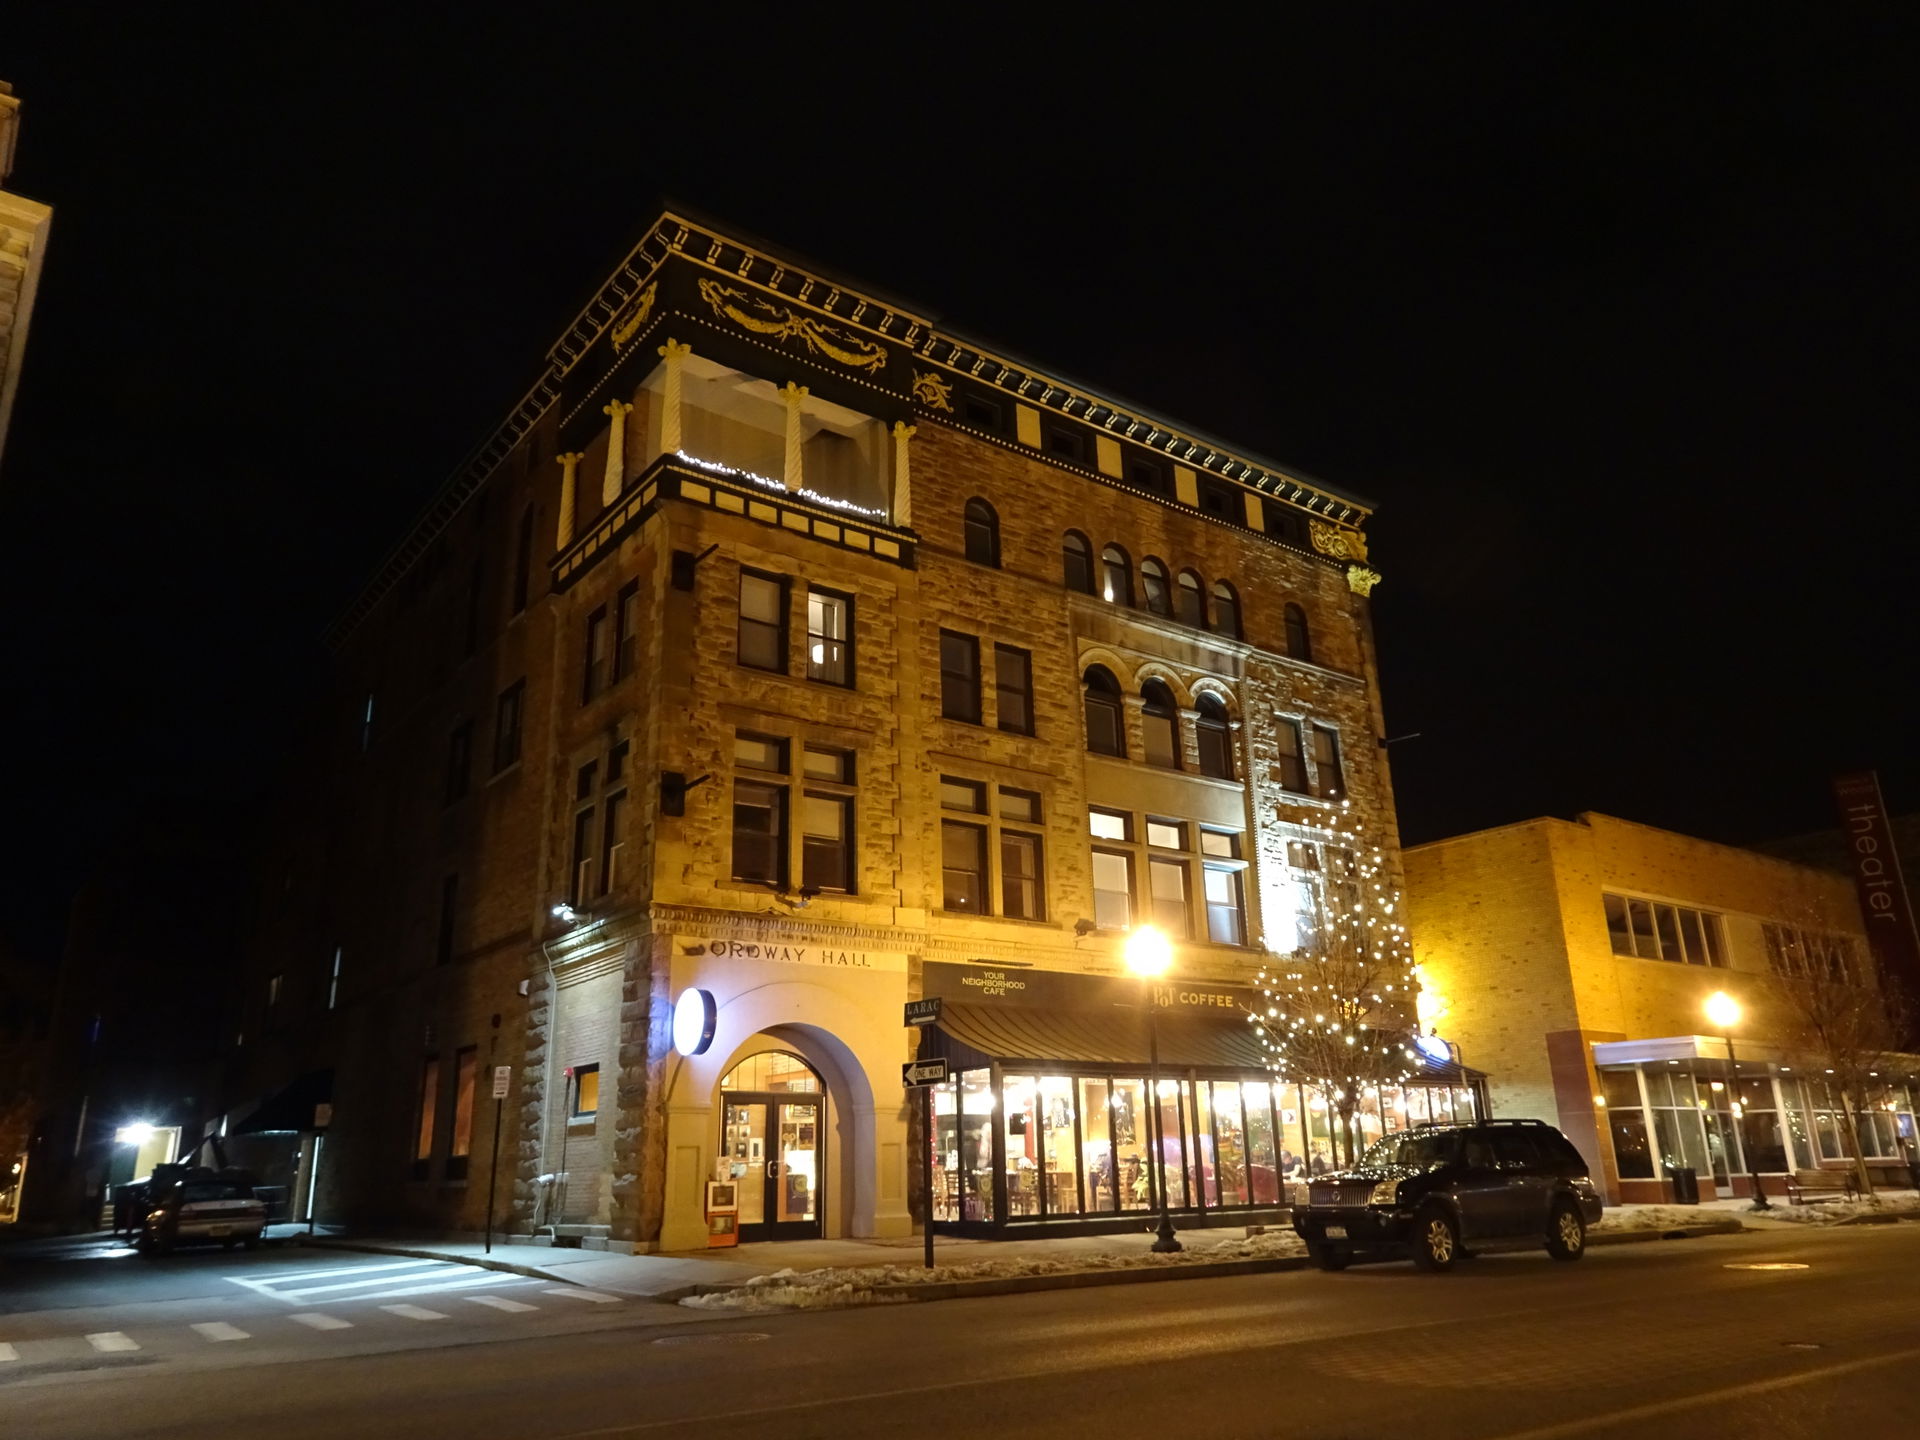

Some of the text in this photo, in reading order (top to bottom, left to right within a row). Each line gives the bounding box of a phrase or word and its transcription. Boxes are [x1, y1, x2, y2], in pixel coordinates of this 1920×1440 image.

[1847, 803, 1896, 922] theater
[710, 939, 871, 968] ORDWAY HALL
[962, 977, 1026, 990] NEIGHBORHOOD
[983, 971, 1005, 981] YOUR
[1145, 985, 1234, 1008] POT COFFEE
[907, 1000, 939, 1015] LARAC
[914, 1066, 942, 1079] ONE WAY
